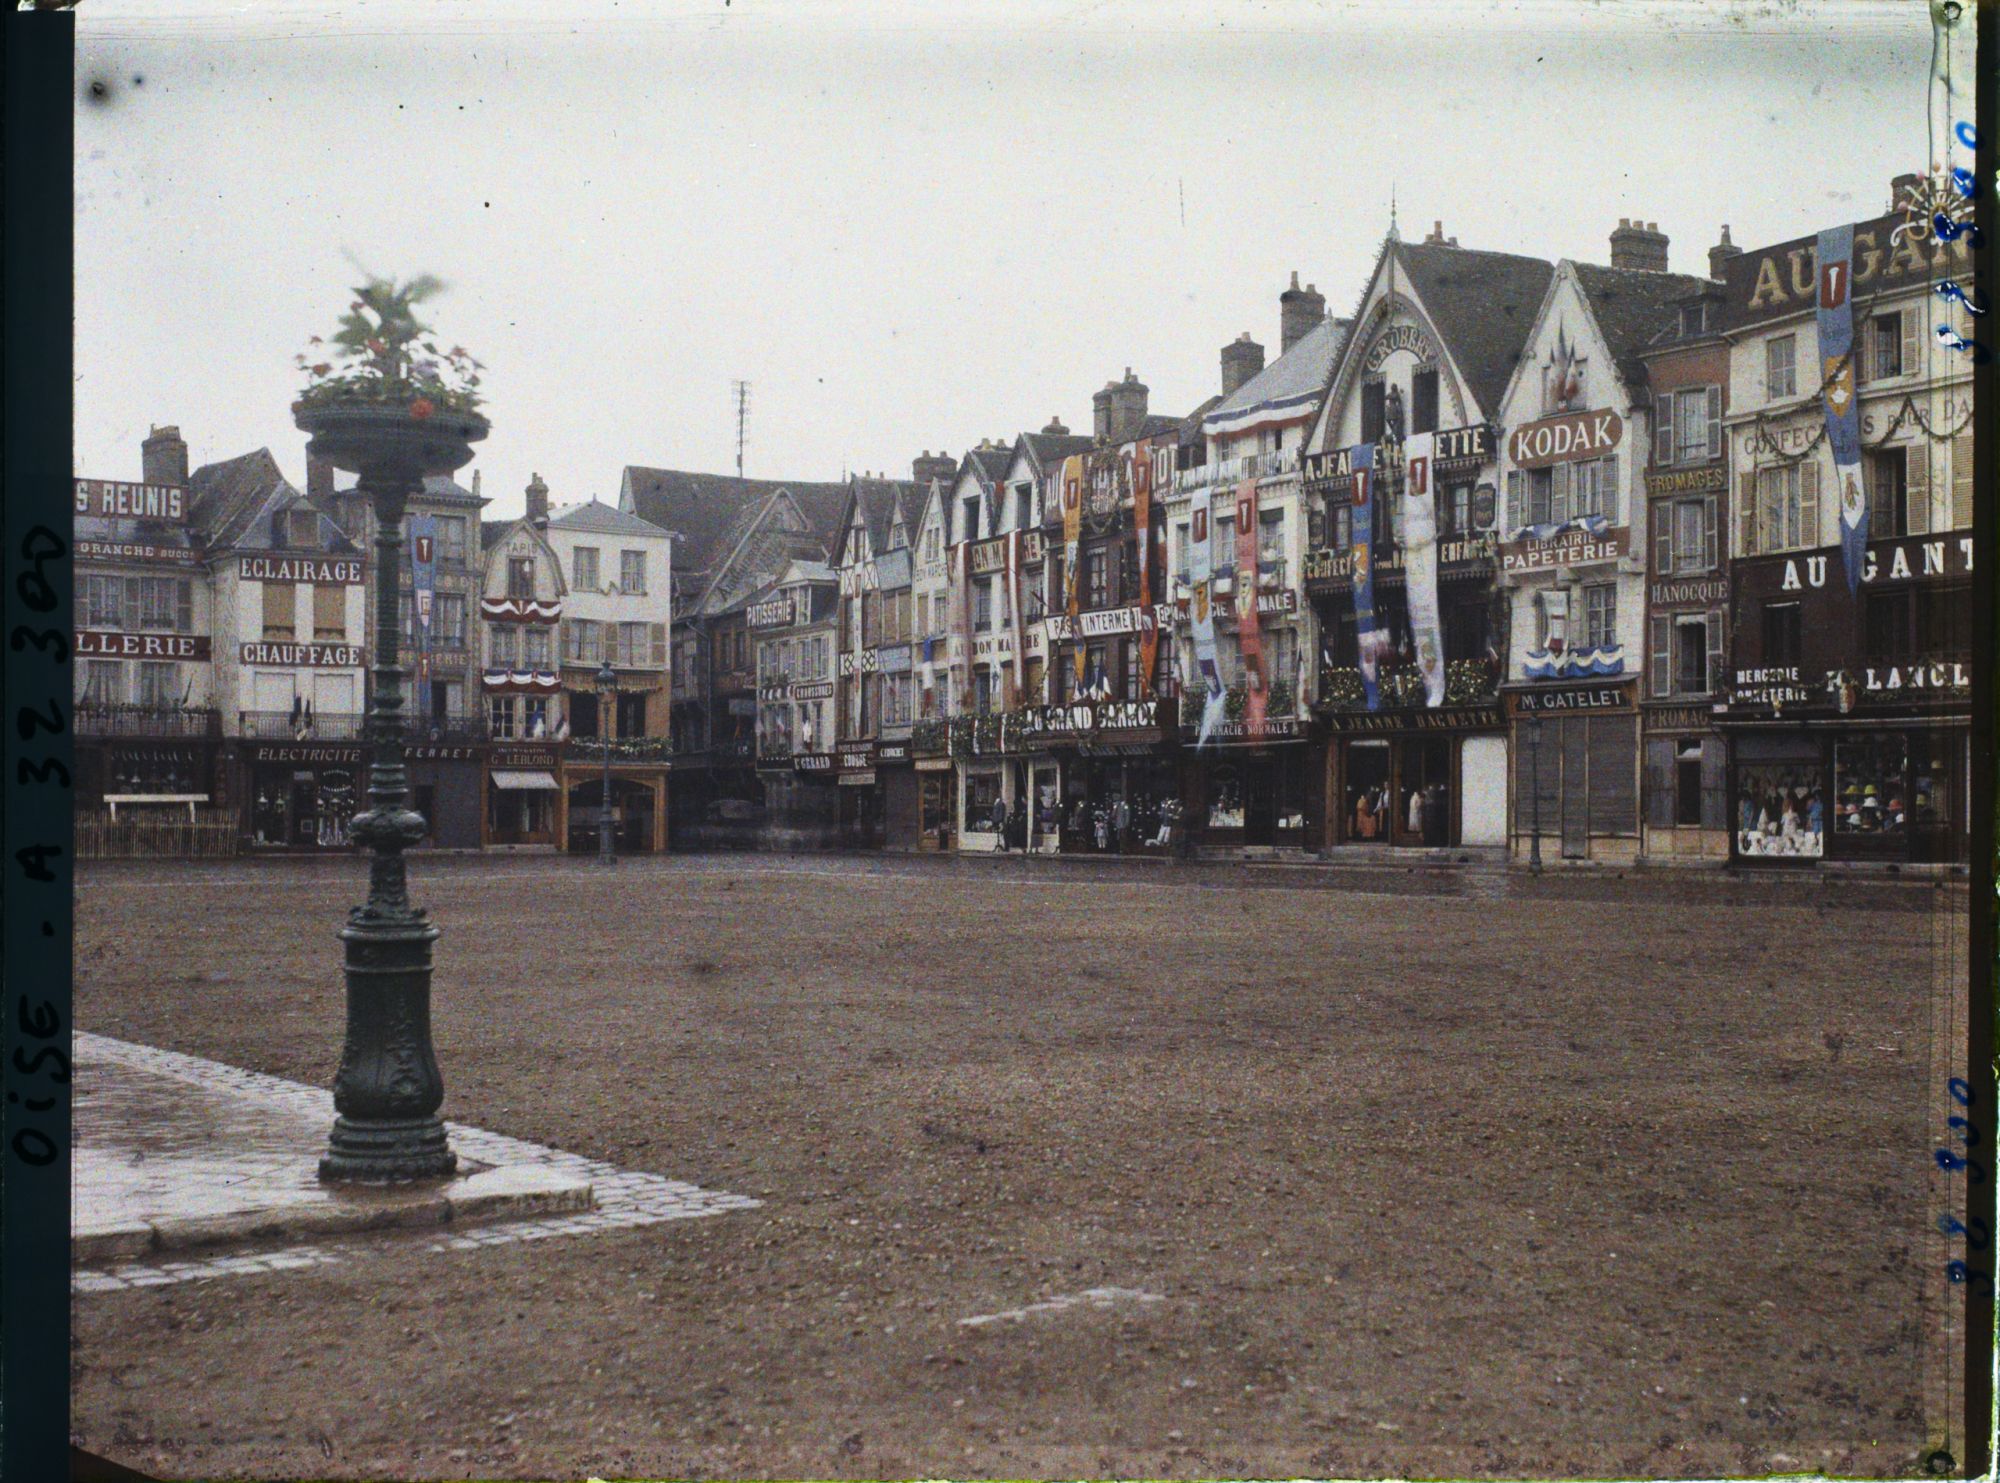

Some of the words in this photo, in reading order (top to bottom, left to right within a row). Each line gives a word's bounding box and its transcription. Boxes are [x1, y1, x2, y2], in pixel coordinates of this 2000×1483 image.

[1748, 246, 1818, 309] AU
[1517, 415, 1614, 461] KODAK
[1316, 445, 1382, 480] JEAE
[1649, 468, 1725, 491] FROMAGES
[102, 483, 182, 518] REUNIS
[1527, 533, 1597, 551] LIBRAIRIE
[1504, 541, 1618, 569] PAPETERIE
[241, 558, 361, 582] ECLAIRAGE
[1782, 556, 1827, 590] AU
[1652, 581, 1728, 603] HANOCQUE
[746, 599, 791, 628] PATISSERIE
[76, 633, 196, 657] LLERIE
[998, 633, 1040, 652] MAHE
[243, 644, 360, 665] CHAUFFAGE
[1737, 667, 1799, 684] MERCERIE
[1543, 690, 1621, 709] GATELET
[1248, 721, 1289, 736] NORMALE
[1348, 714, 1404, 731] JEANNE
[1416, 710, 1500, 729] HACHETTE
